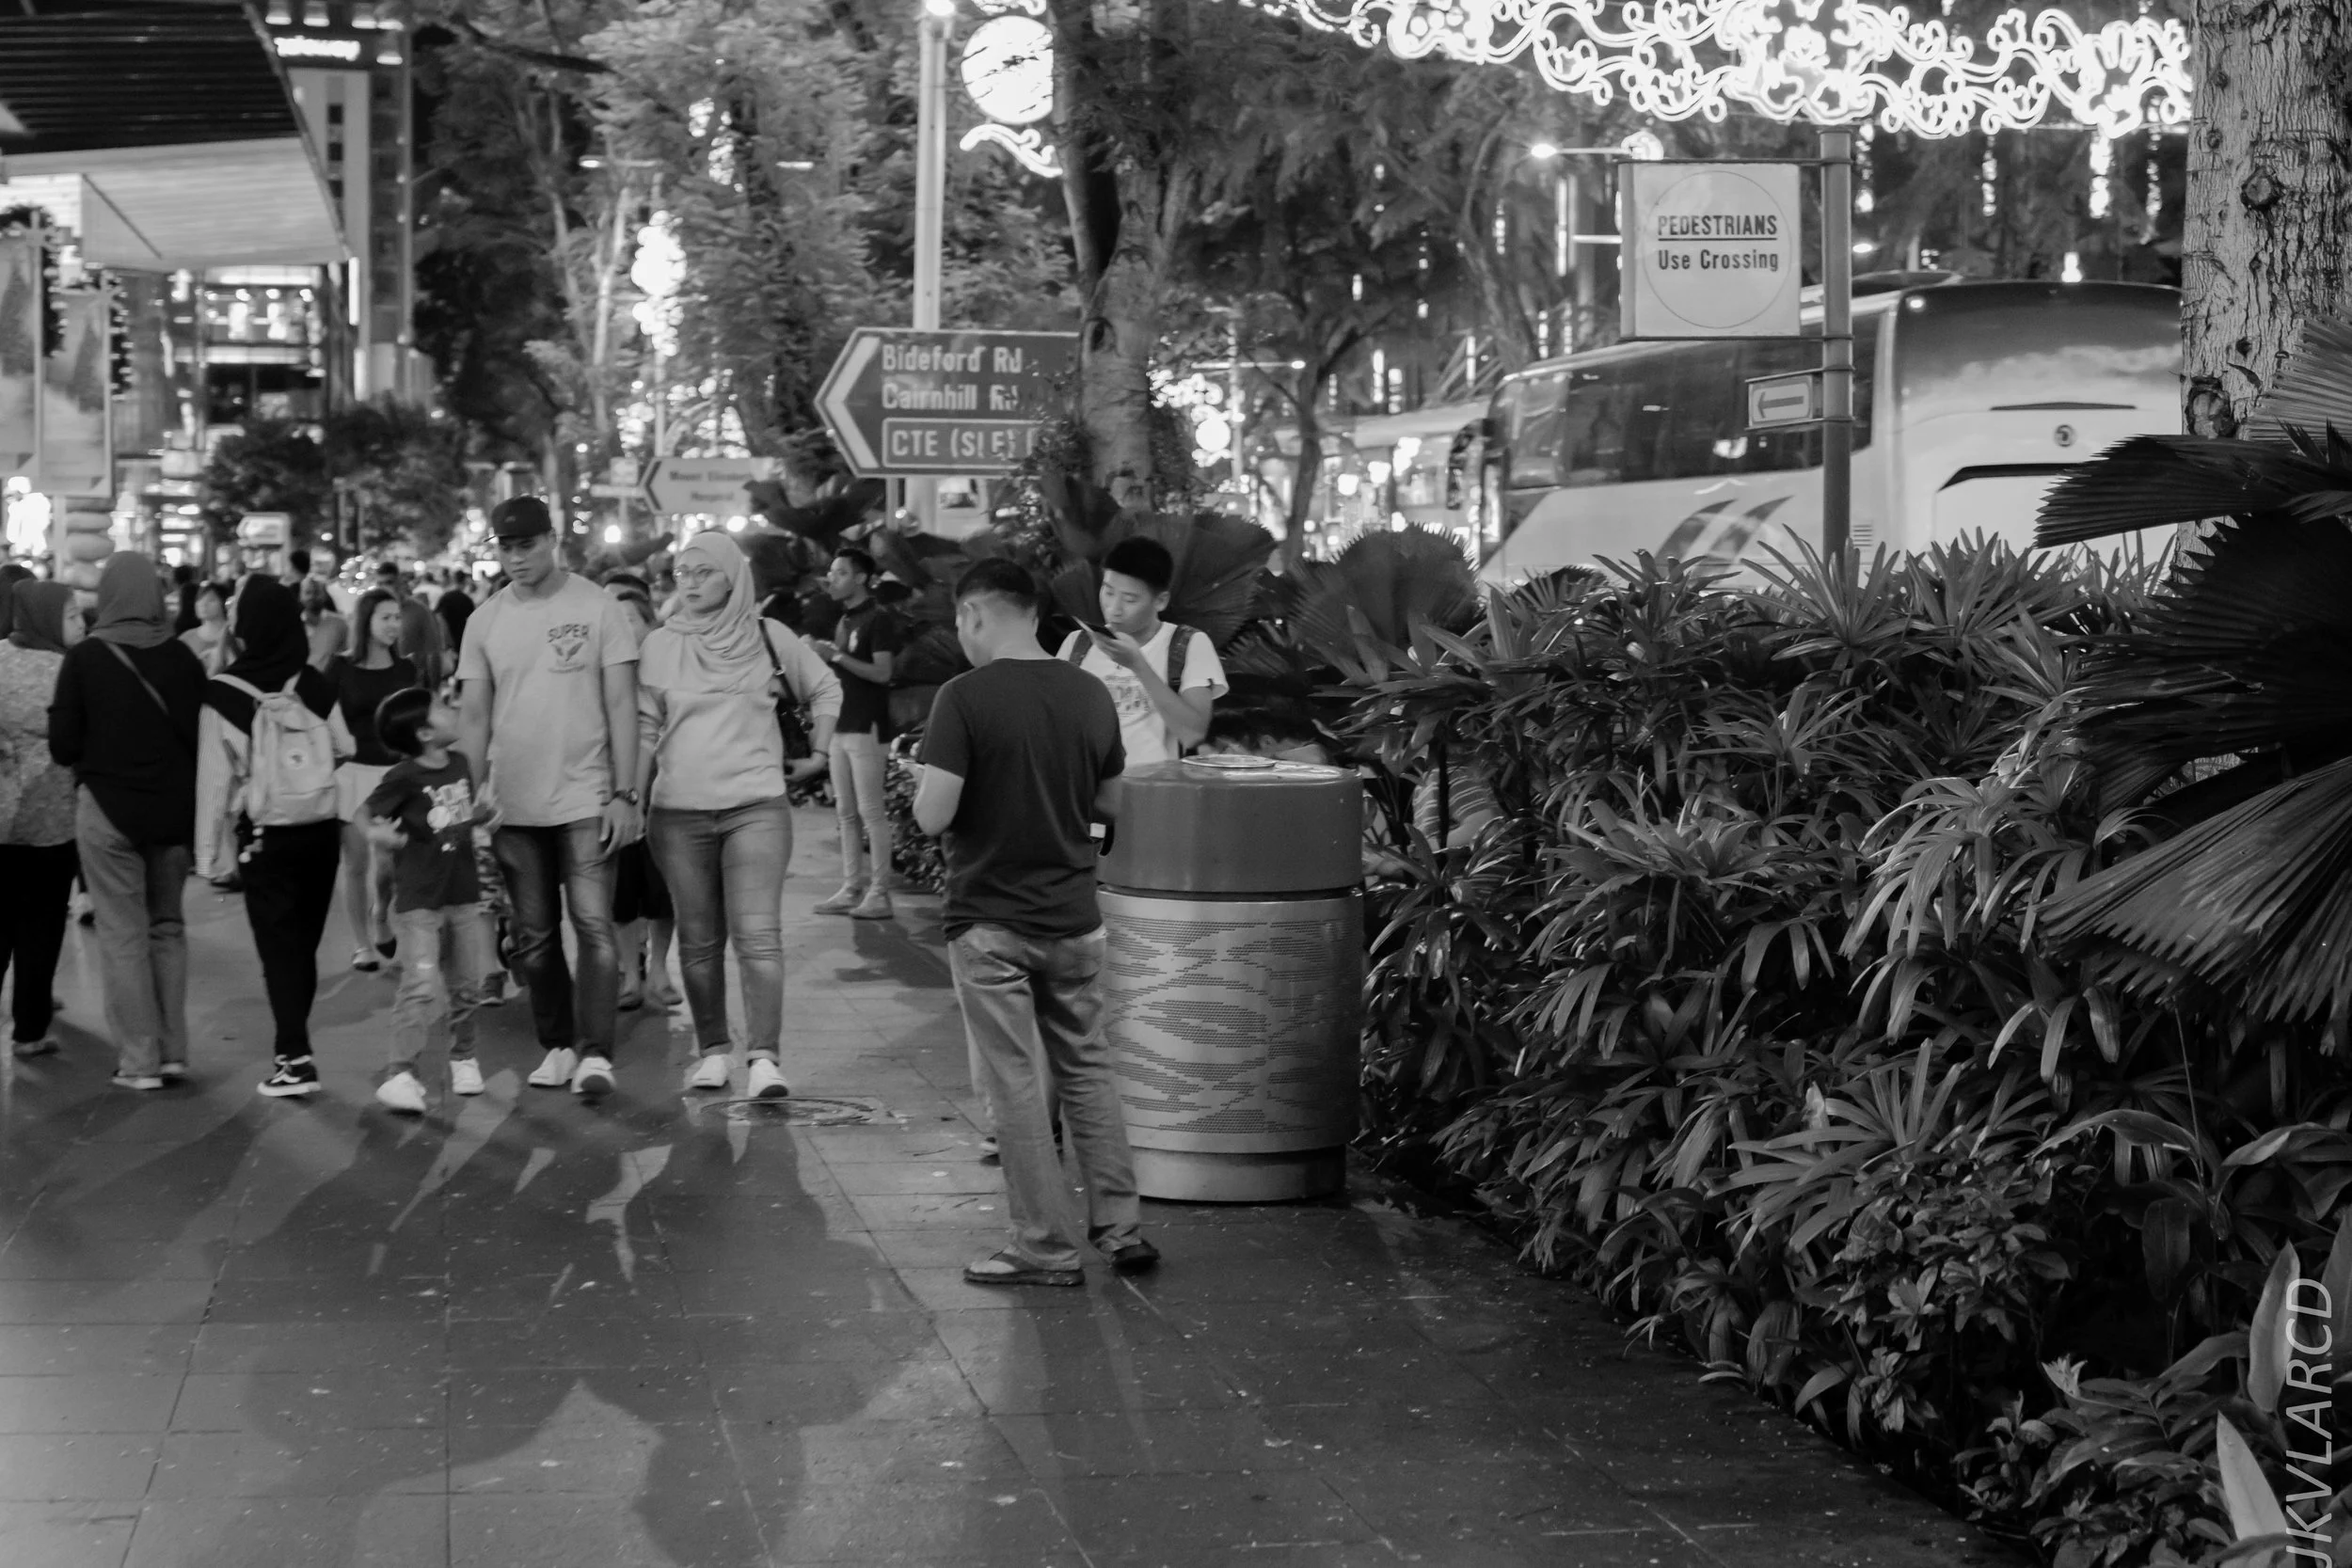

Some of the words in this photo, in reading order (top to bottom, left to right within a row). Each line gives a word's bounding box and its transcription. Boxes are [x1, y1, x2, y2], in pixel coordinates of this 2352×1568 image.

[1658, 214, 1777, 236] PEDESTRIANS
[1659, 249, 1691, 270] Use
[1700, 248, 1778, 272] Crossing
[882, 344, 982, 372] Bideford
[993, 346, 1022, 373] Rd
[882, 383, 978, 410] Cairnhill
[893, 429, 939, 456] CTE
